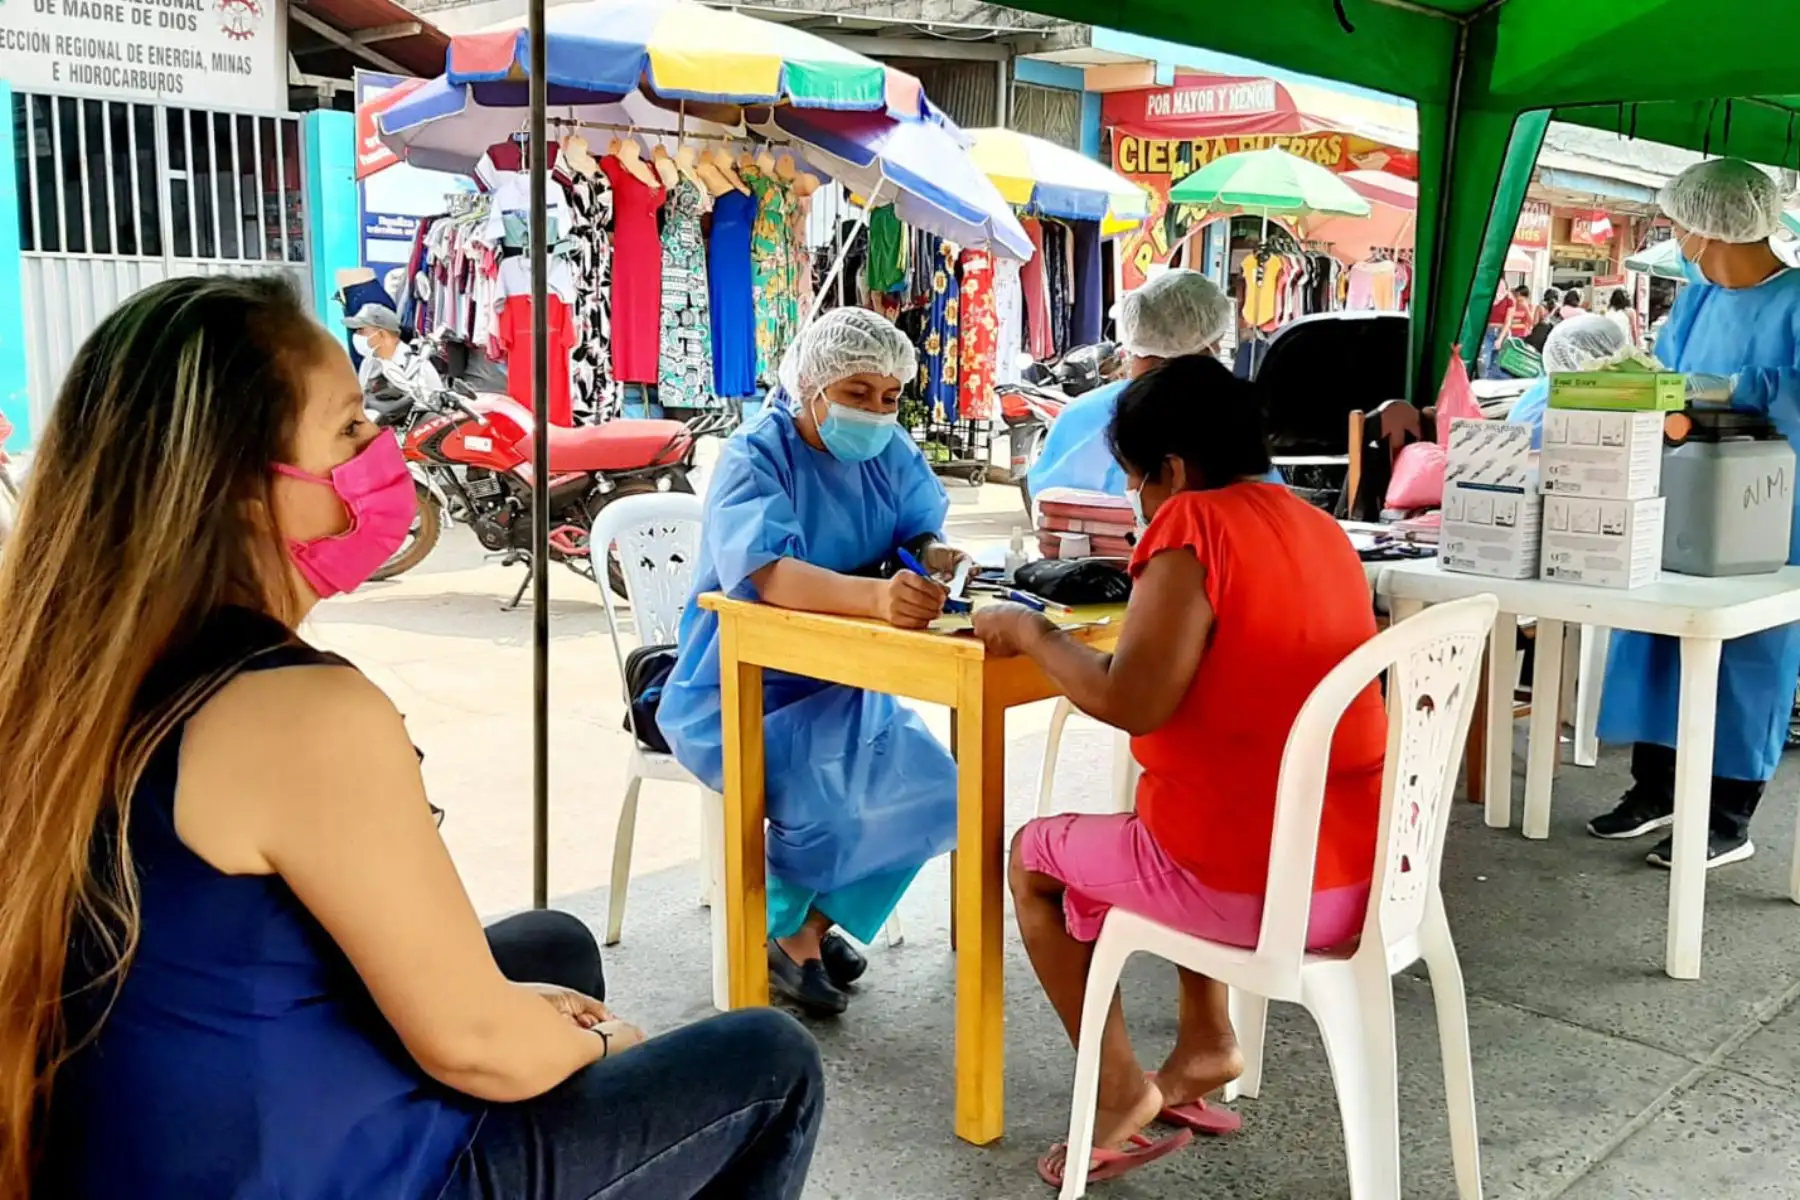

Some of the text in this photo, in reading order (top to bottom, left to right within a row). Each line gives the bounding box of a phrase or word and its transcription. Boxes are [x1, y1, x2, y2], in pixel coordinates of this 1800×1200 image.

[34, 0, 197, 32] DE MADRE DE DIOS
[56, 34, 122, 61] REGIONAL
[127, 42, 143, 64] DE
[211, 51, 252, 75] MINAS
[52, 61, 184, 94] E HIDROCARBUROS
[1147, 81, 1276, 116] POR MAYOR Y MENOR
